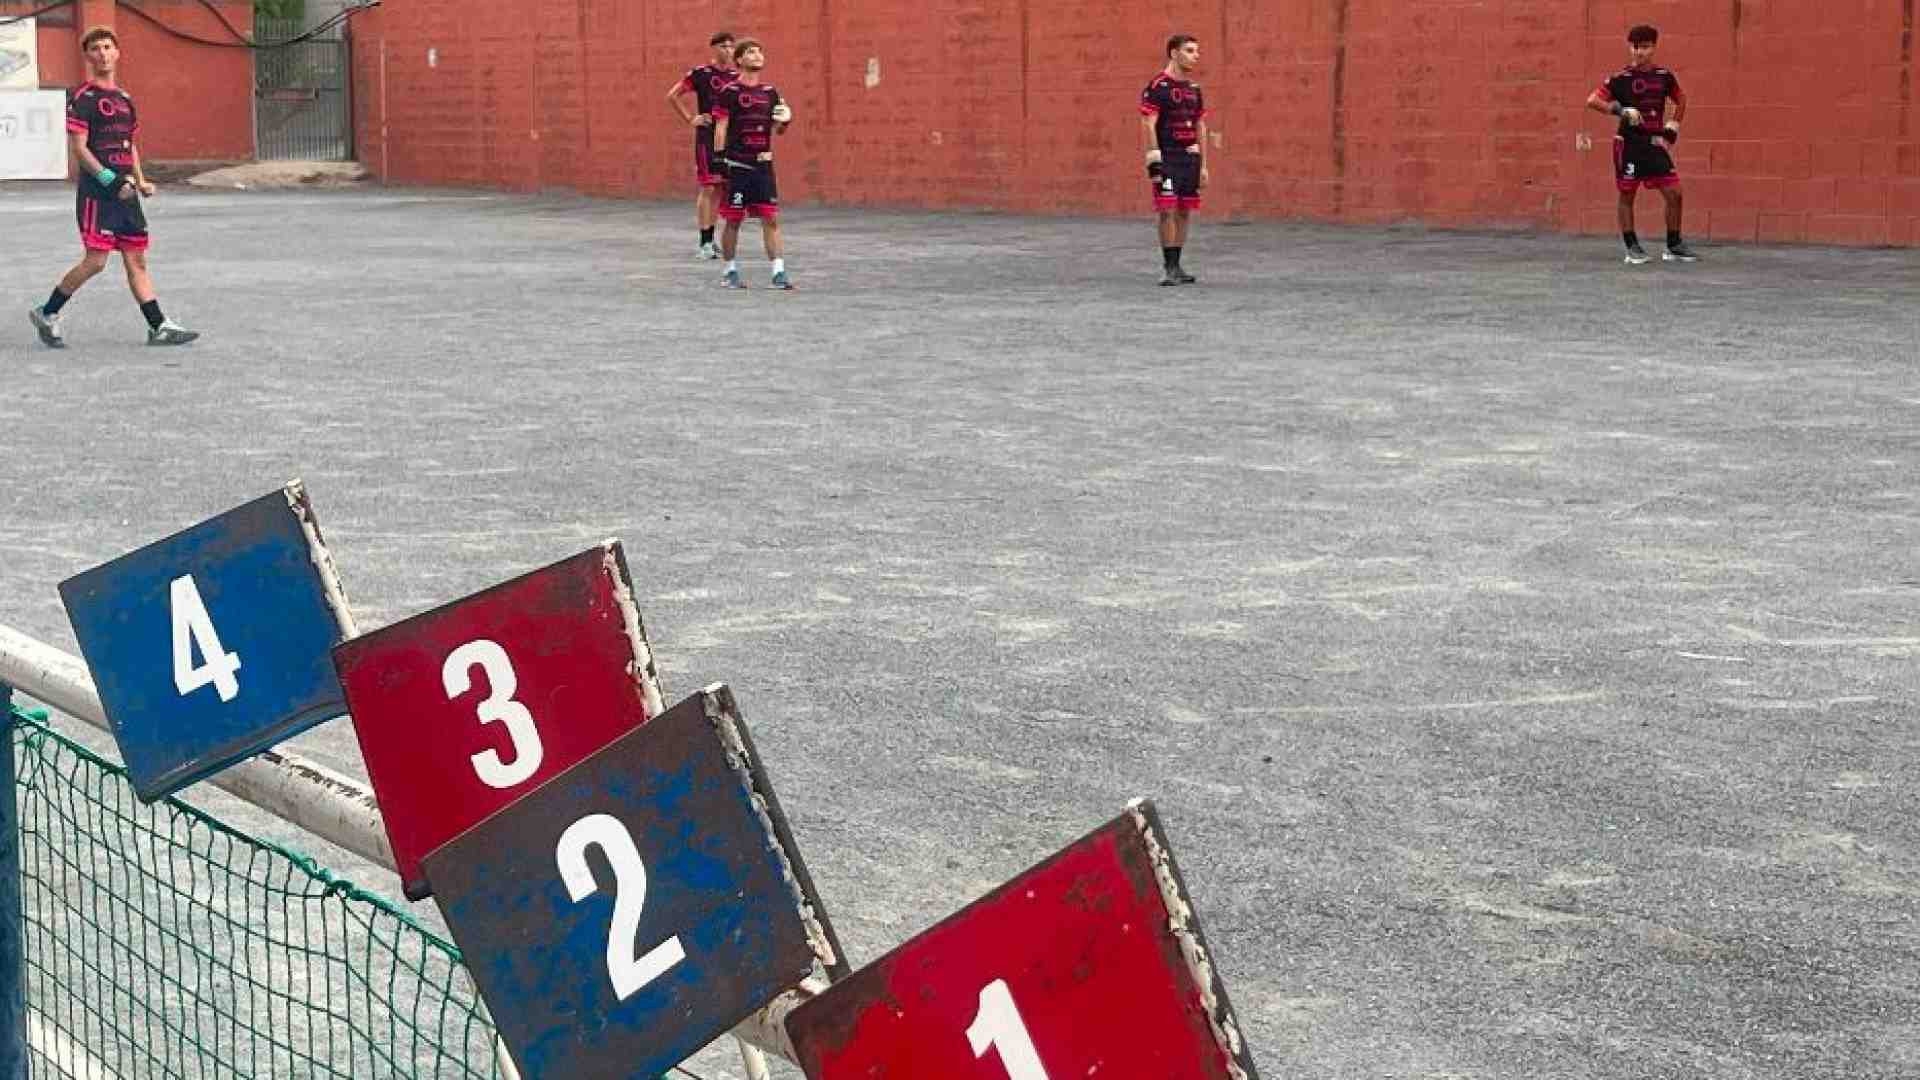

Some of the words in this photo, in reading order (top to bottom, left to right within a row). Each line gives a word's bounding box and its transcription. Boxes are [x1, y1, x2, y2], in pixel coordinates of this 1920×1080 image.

[1162, 177, 1172, 190] 4
[170, 573, 241, 702] 4
[442, 639, 543, 789] 3
[556, 814, 686, 1001] 2
[965, 978, 1050, 1080] 1
